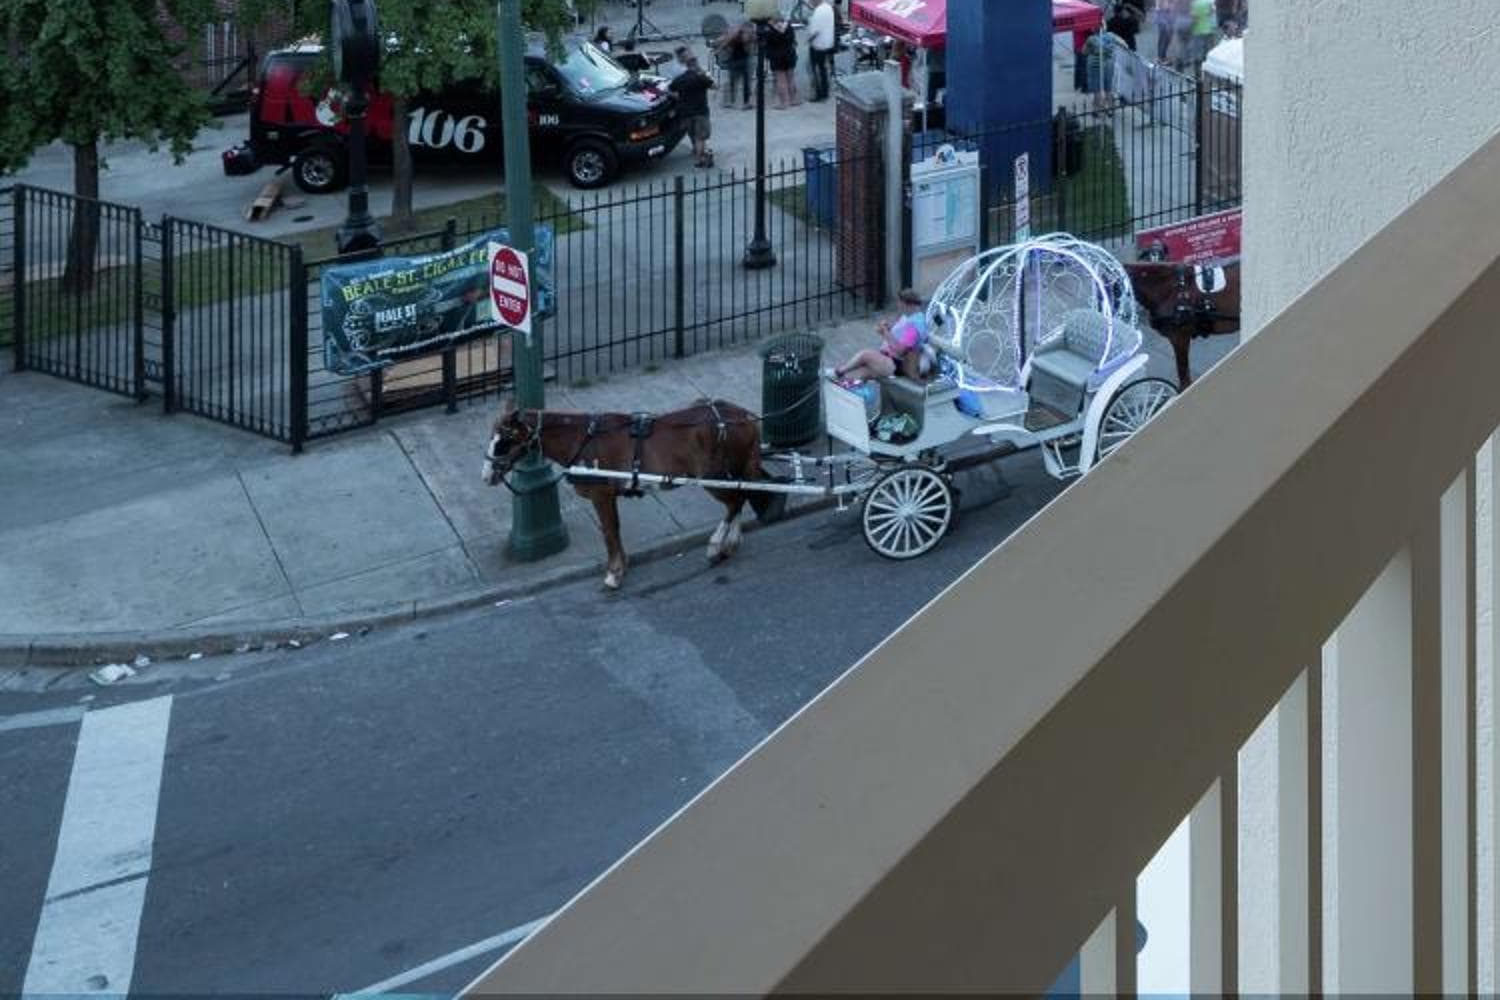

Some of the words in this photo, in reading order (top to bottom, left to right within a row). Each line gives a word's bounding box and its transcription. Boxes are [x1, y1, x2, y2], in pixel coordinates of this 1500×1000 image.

[407, 107, 486, 154] 106
[495, 259, 505, 274] DO
[507, 263, 523, 280] NOT
[341, 275, 392, 301] BEALE
[499, 294, 521, 313] ENTER
